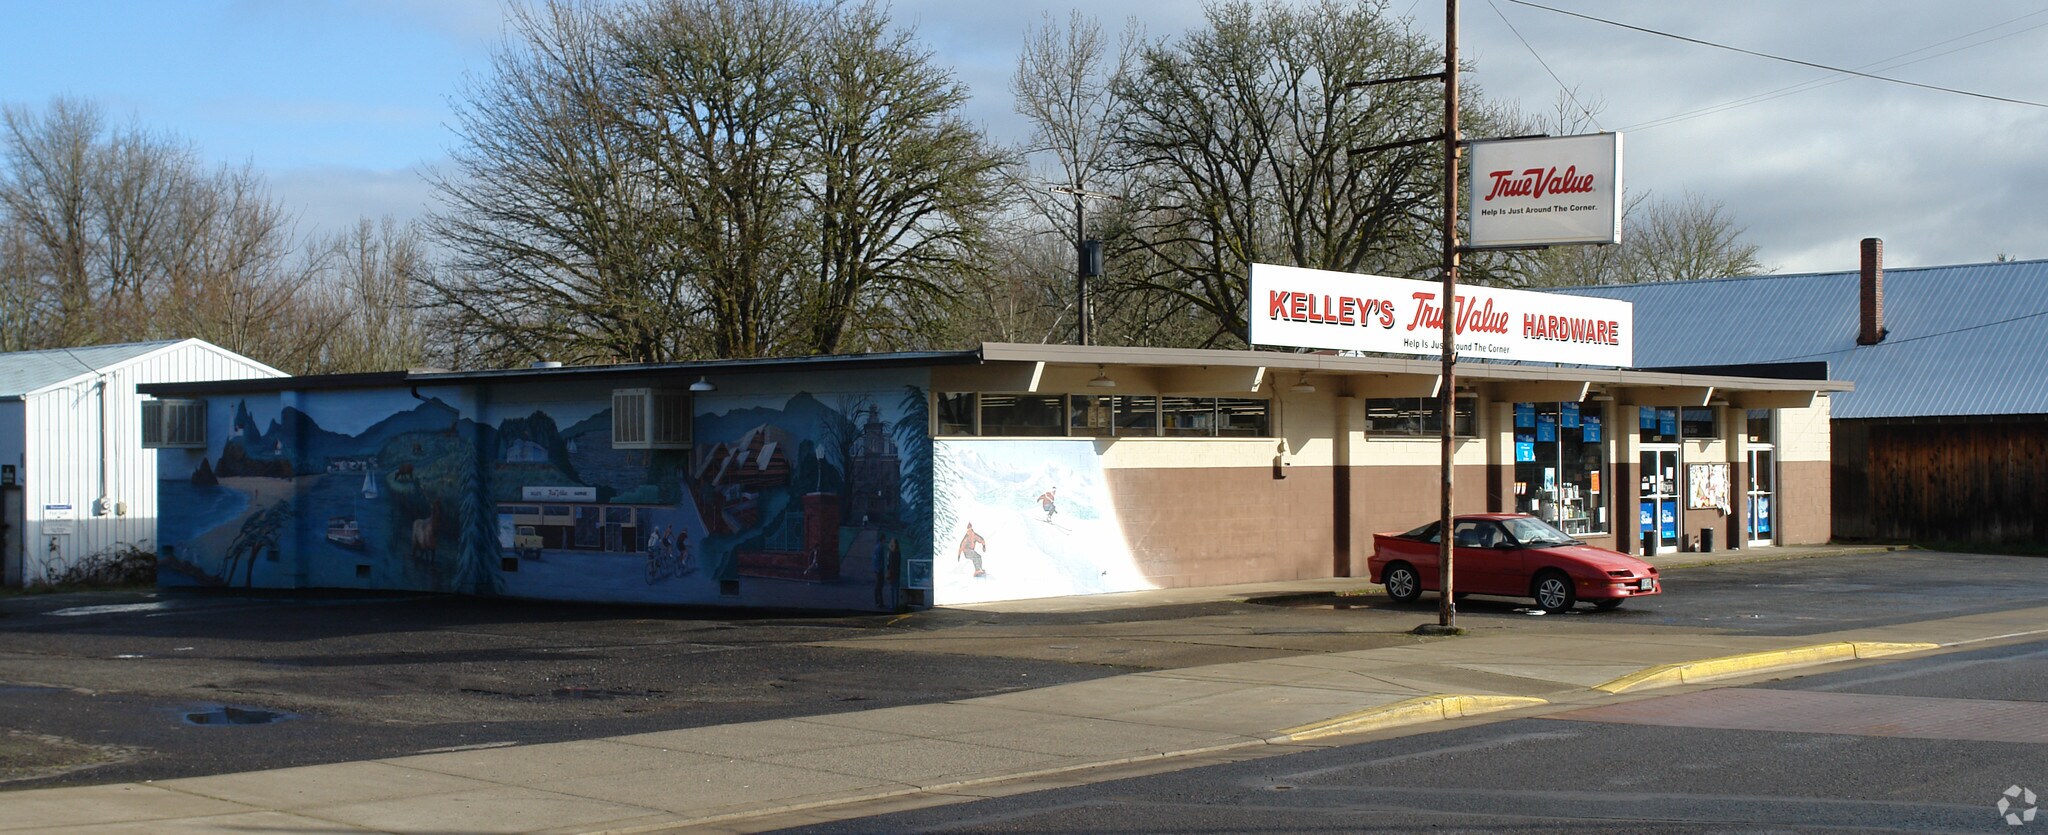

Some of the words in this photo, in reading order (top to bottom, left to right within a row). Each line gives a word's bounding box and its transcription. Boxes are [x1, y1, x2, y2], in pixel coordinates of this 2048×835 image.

[1481, 209, 1498, 217] Help
[1508, 207, 1524, 215] Just
[1525, 206, 1552, 214] Around
[1269, 290, 1395, 329] KELLEY'S
[1406, 292, 1444, 331] Tru
[1523, 313, 1619, 346] HARDWARE
[1403, 338, 1420, 349] Help
[1421, 339, 1429, 348] Is
[1431, 340, 1443, 349] Jus
[1454, 343, 1472, 351] ound
[1474, 343, 1487, 352] The
[1661, 513, 1674, 524] Sale
